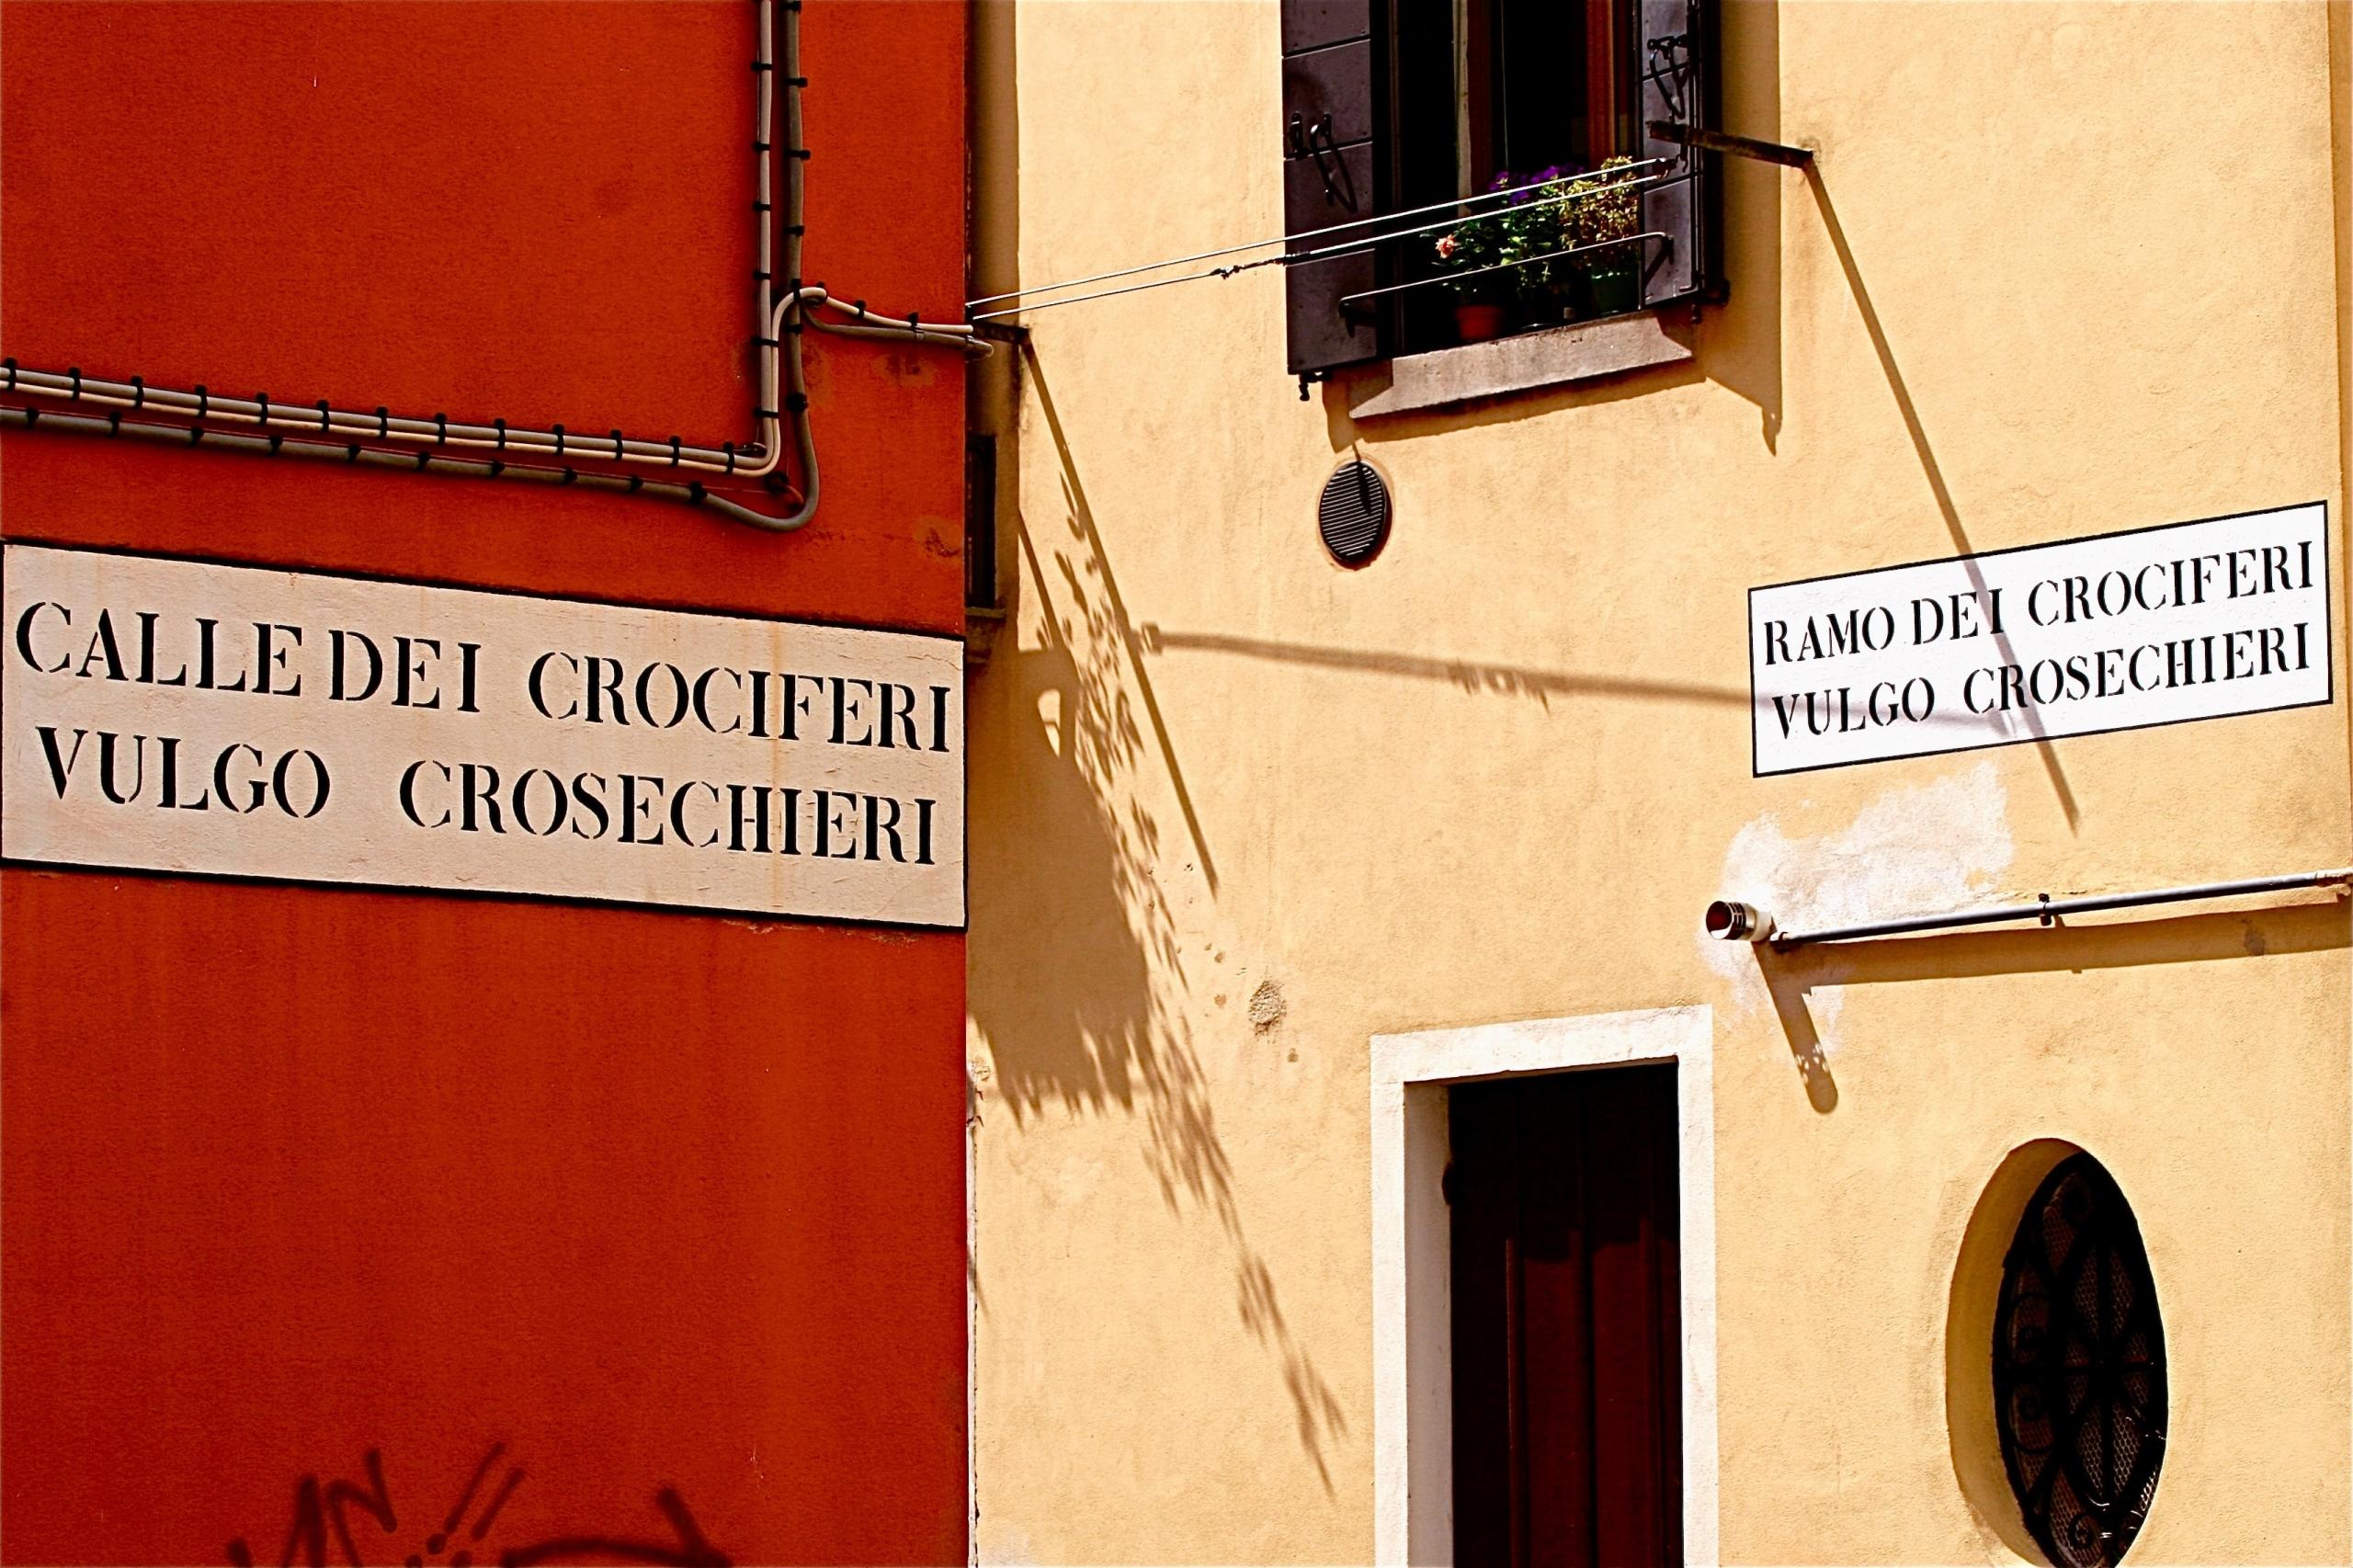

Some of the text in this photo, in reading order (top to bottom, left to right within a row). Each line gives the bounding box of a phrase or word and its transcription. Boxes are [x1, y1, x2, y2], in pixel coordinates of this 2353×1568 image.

[1765, 541, 2313, 665] RAMO DEI CROCIFERI
[17, 602, 950, 752] CALLE DEI CROCIFERI
[1772, 623, 2309, 739] VULGO CROSECHIERI
[36, 727, 936, 865] VULGO CROSECHIERI
